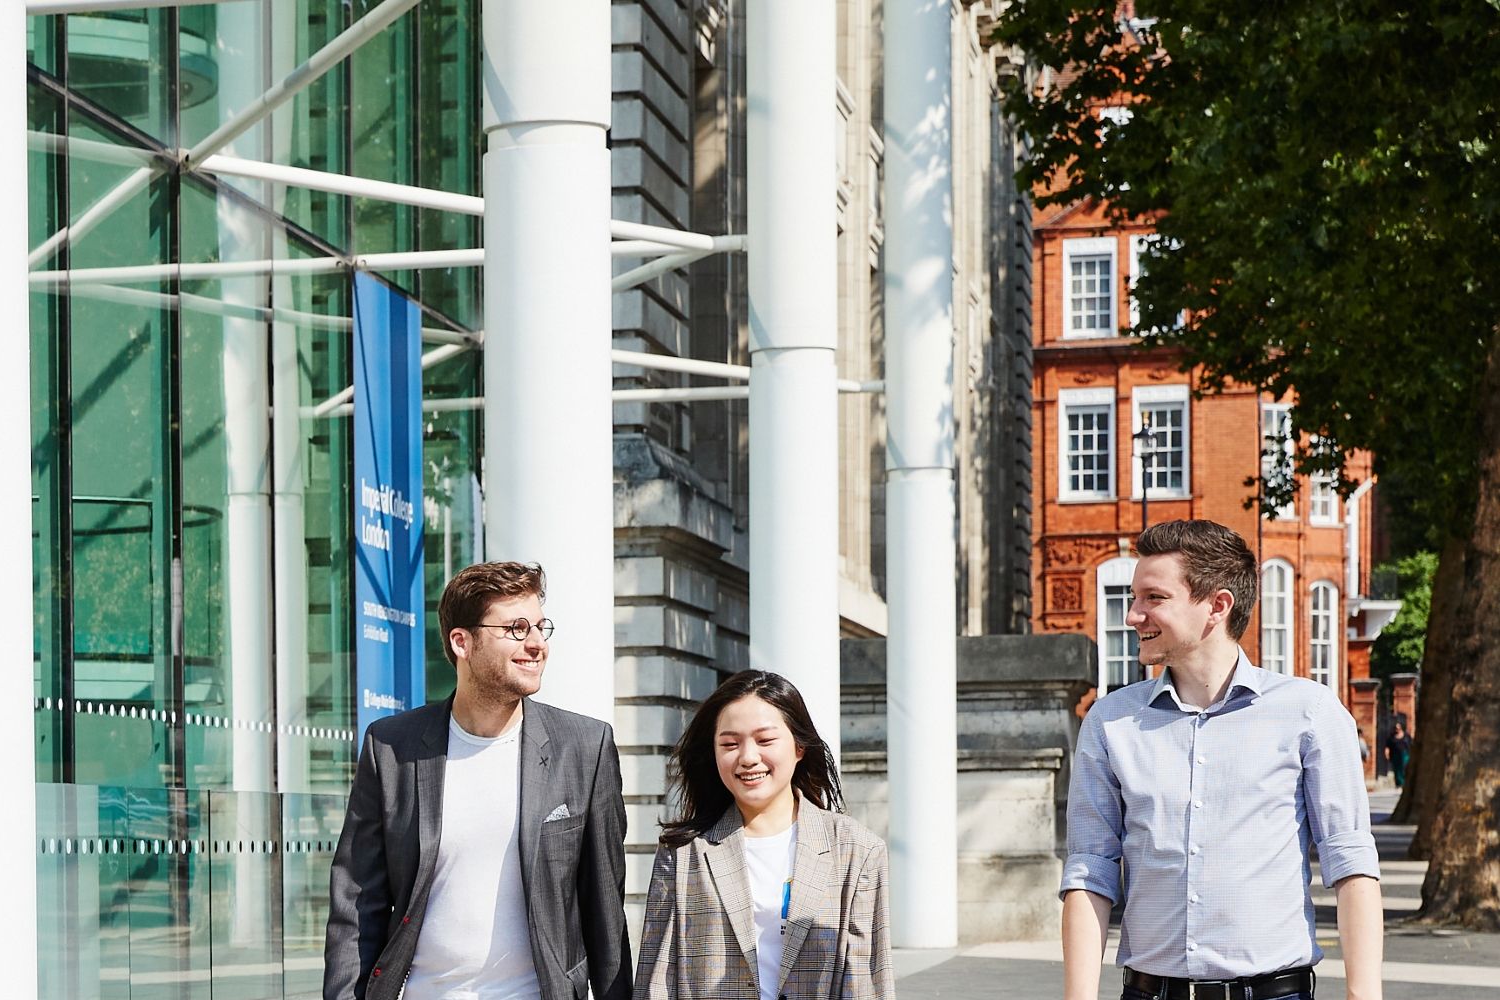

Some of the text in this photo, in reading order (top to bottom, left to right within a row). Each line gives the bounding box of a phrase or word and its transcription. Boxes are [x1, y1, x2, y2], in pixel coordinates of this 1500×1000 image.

[362, 478, 413, 530] Imperial College
[362, 515, 390, 551] London
